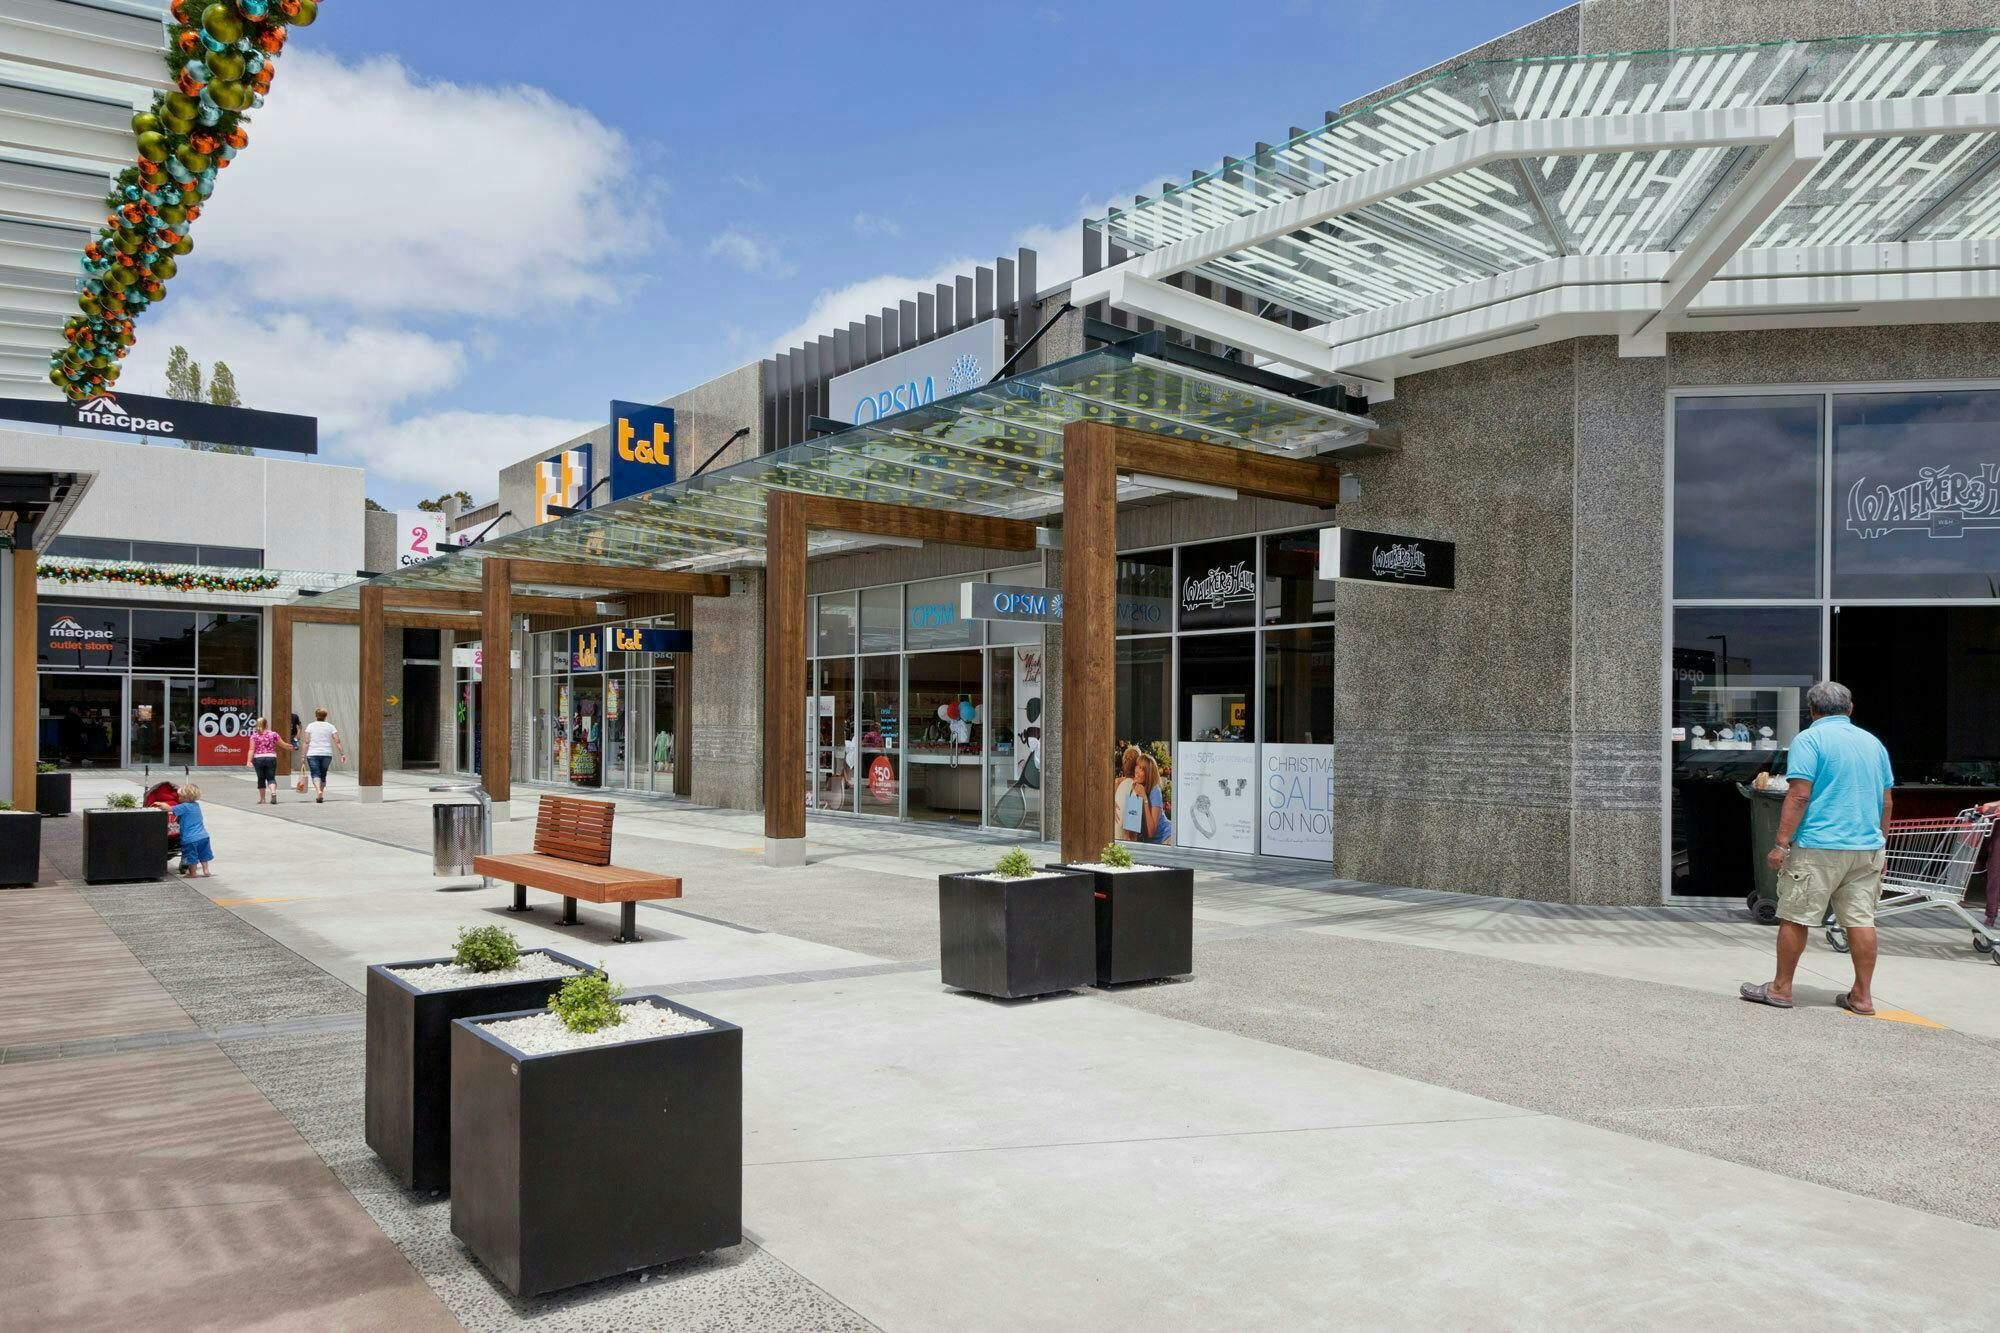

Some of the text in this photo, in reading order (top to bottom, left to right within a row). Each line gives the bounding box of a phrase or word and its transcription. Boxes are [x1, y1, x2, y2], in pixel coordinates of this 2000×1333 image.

[78, 410, 174, 433] macpac
[617, 417, 671, 467] t&t
[410, 526, 430, 554] 2
[993, 591, 1047, 615] OPSM
[911, 602, 955, 628] OPSM
[49, 628, 114, 640] macpac
[616, 628, 643, 650] t&t
[50, 641, 113, 651] outlet store
[578, 632, 597, 667] t&t
[198, 712, 257, 738] 60%
[874, 766, 891, 782] $50
[1268, 810, 1294, 832] ON
